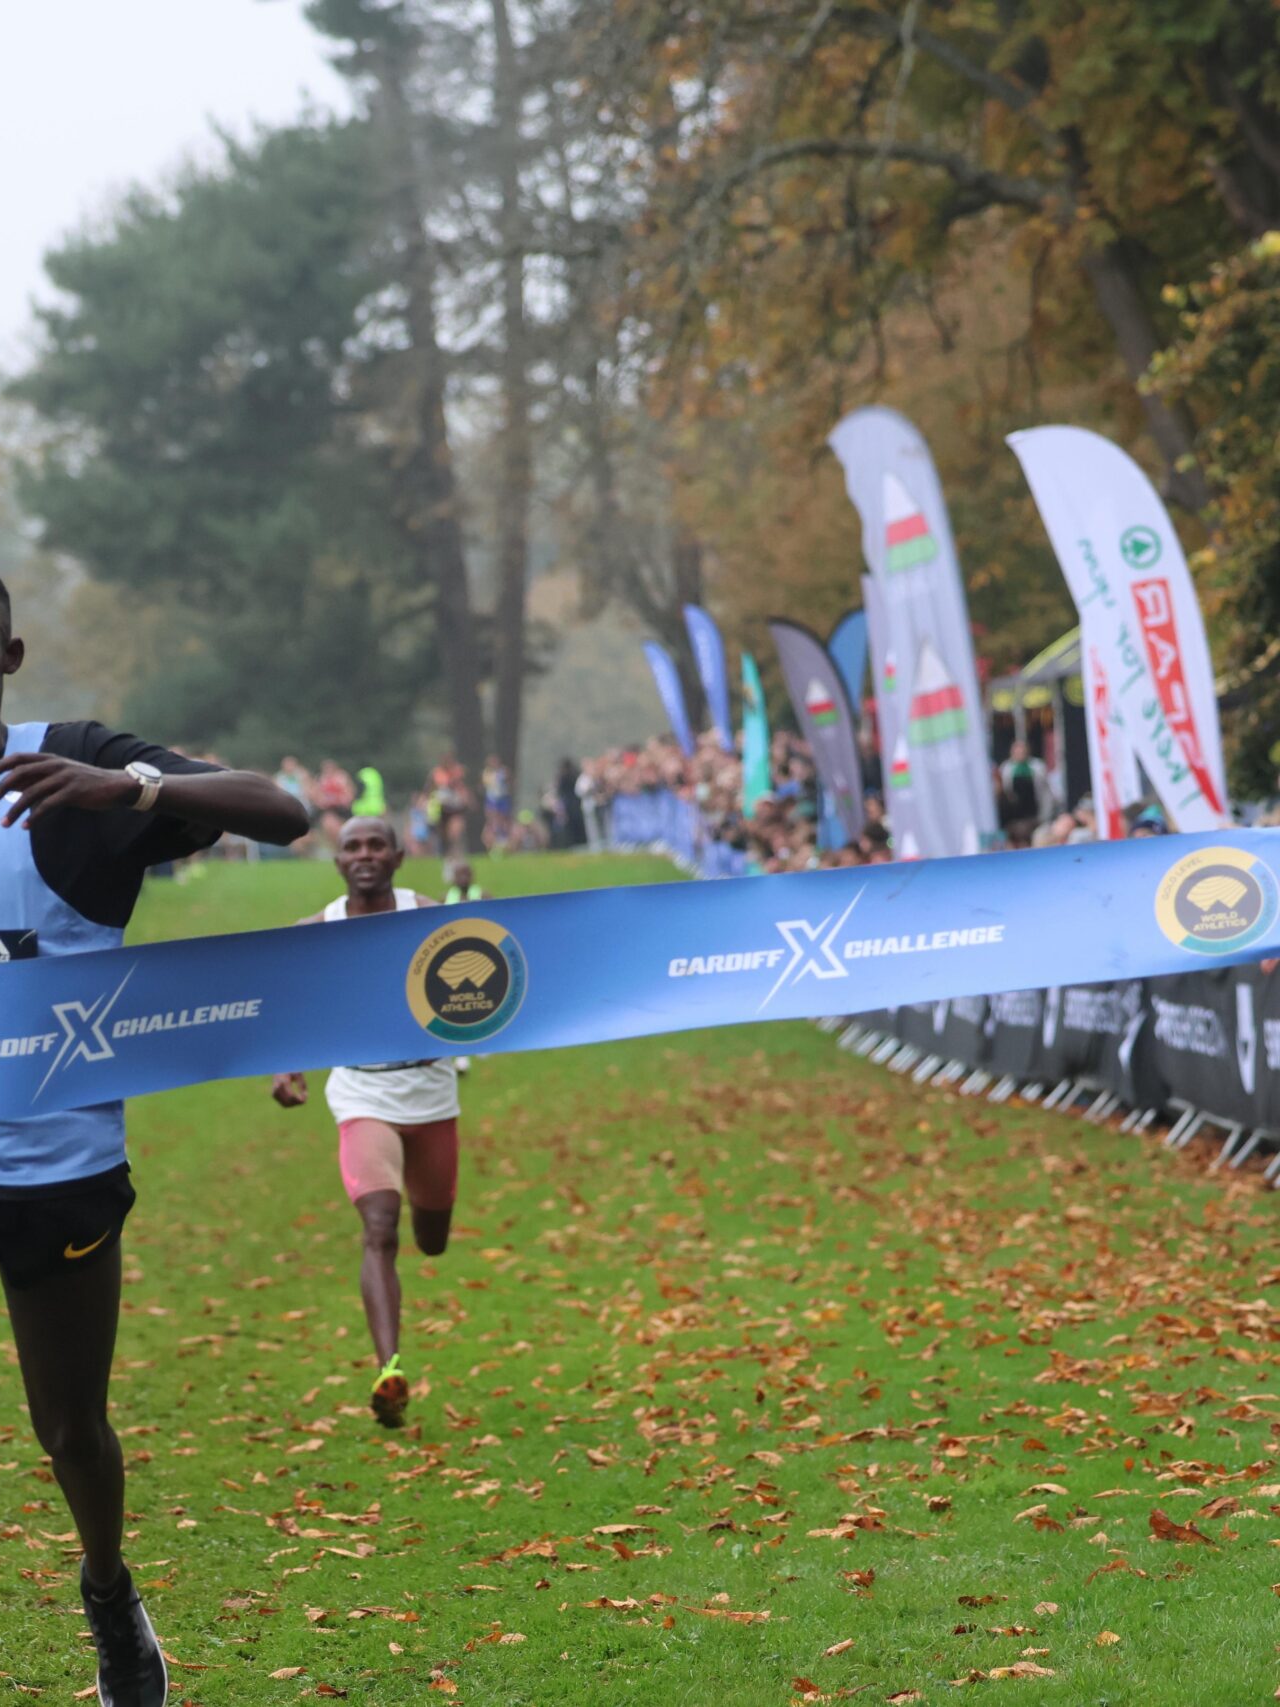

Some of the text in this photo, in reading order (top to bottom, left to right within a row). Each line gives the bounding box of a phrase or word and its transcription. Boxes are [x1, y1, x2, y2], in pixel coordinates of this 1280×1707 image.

[1200, 911, 1238, 923] WORLD
[1193, 918, 1247, 932] ATHLETICS
[668, 948, 785, 978] CARDIFF
[843, 925, 1006, 959] CHALLENGE
[448, 991, 486, 1002] WORLD
[440, 1000, 493, 1012] ATHLETICS
[112, 998, 263, 1038] CHALLENGE
